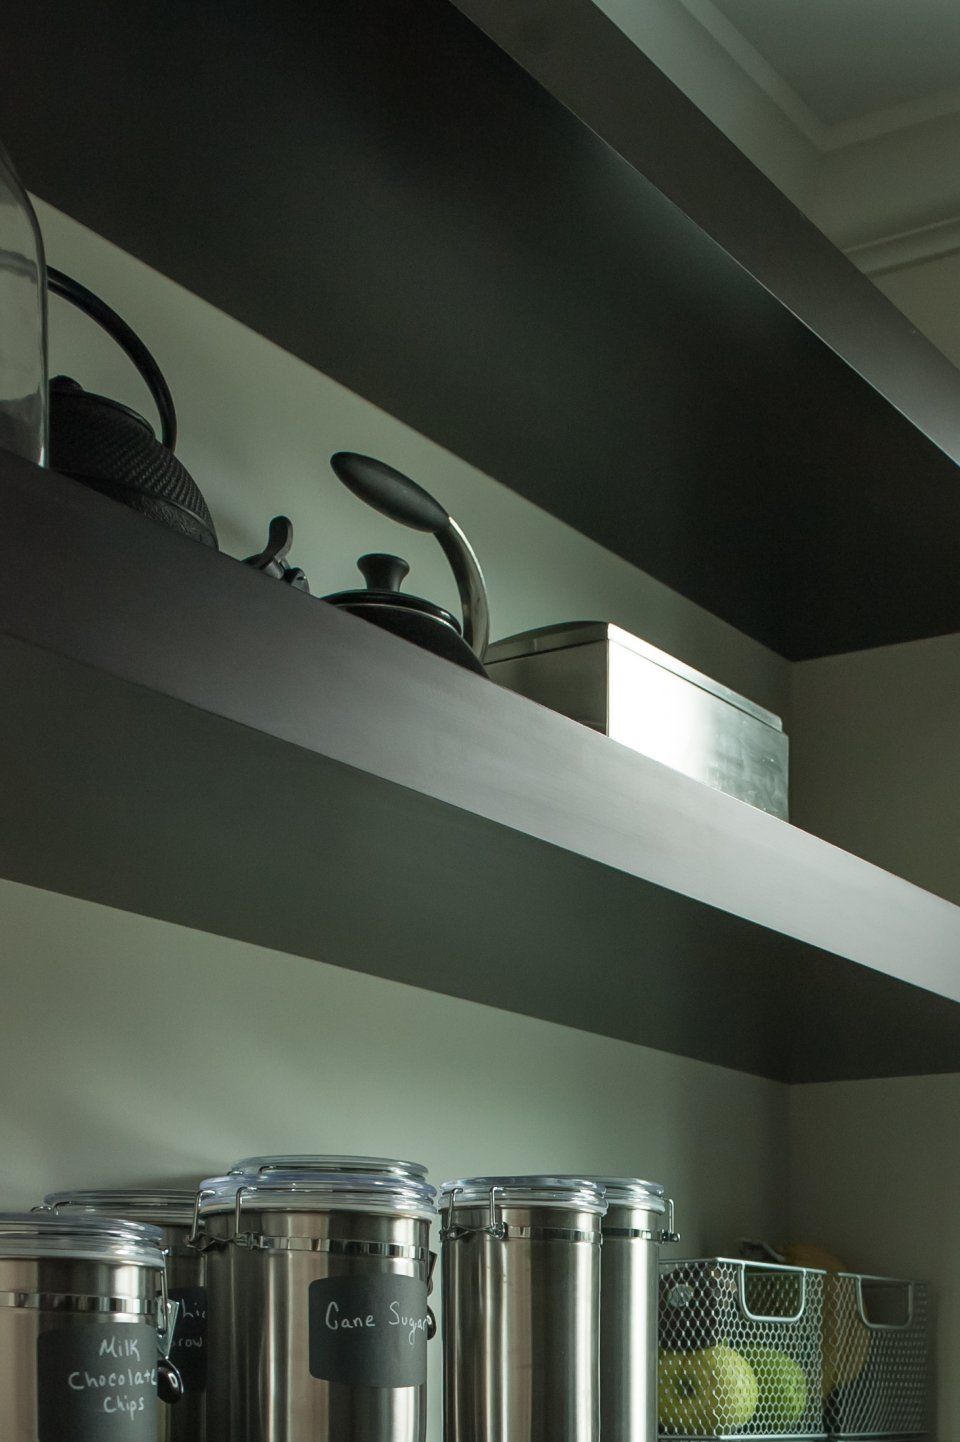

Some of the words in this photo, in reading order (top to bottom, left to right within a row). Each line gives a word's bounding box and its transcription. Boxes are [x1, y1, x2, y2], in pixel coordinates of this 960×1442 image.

[325, 1301, 376, 1331] Cane
[99, 1336, 140, 1362] Milk
[68, 1368, 158, 1390] Chocolate
[103, 1395, 145, 1421] Chips
